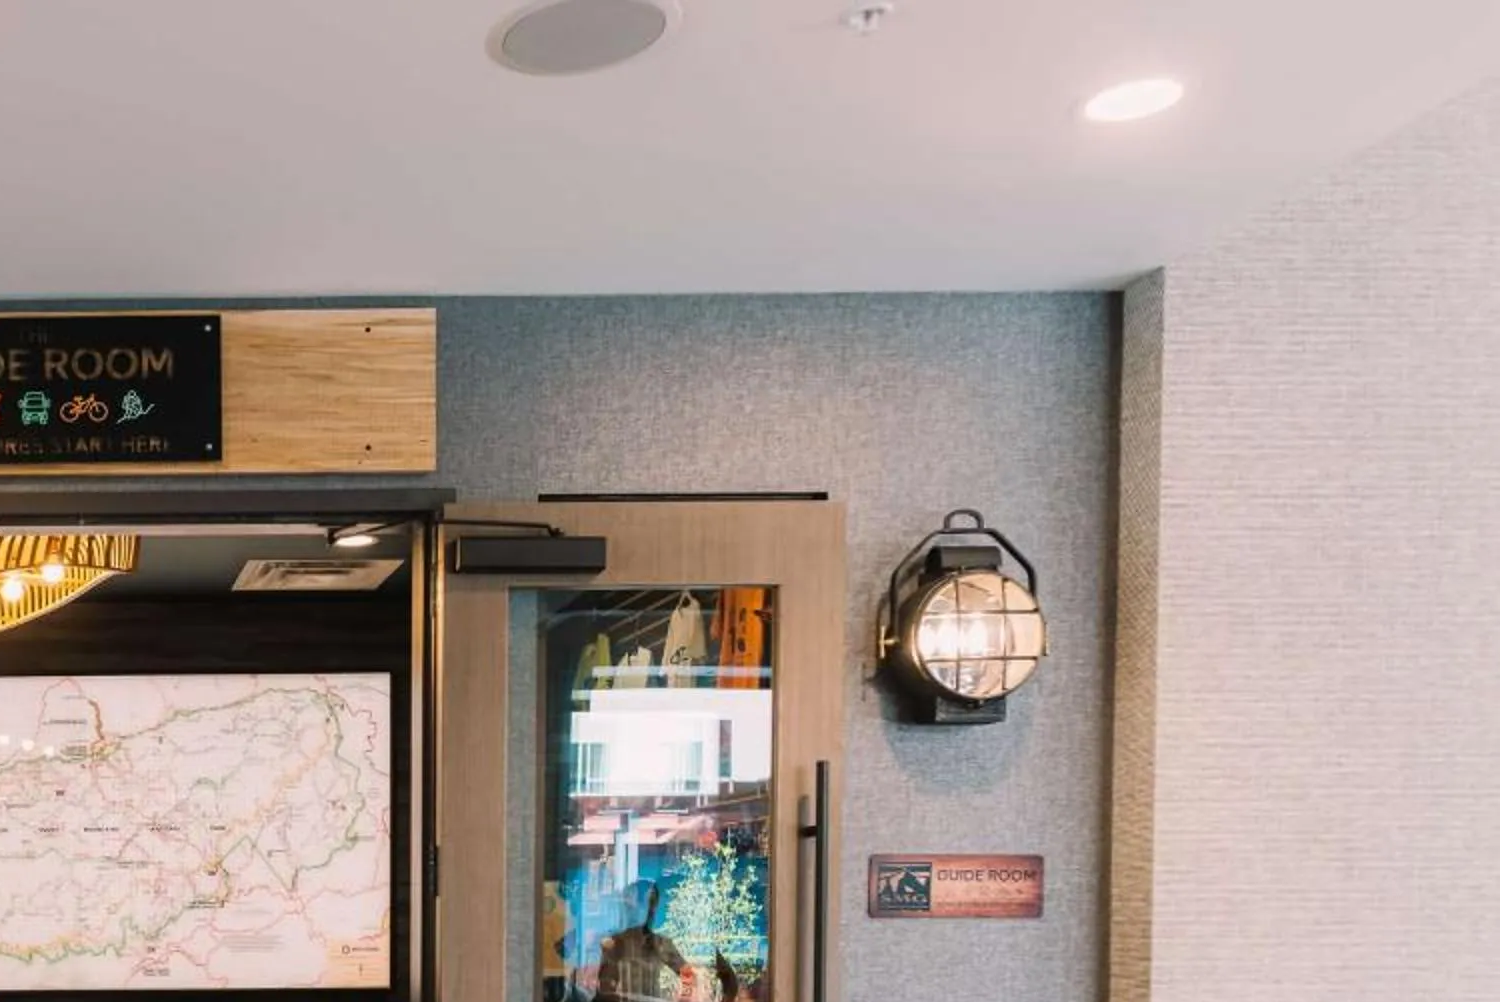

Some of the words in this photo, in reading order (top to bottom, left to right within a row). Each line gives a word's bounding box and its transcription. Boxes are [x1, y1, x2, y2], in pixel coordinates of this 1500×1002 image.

[44, 346, 174, 381] ROOM
[937, 869, 983, 882] GUIDE
[988, 868, 1037, 882] ROOM
